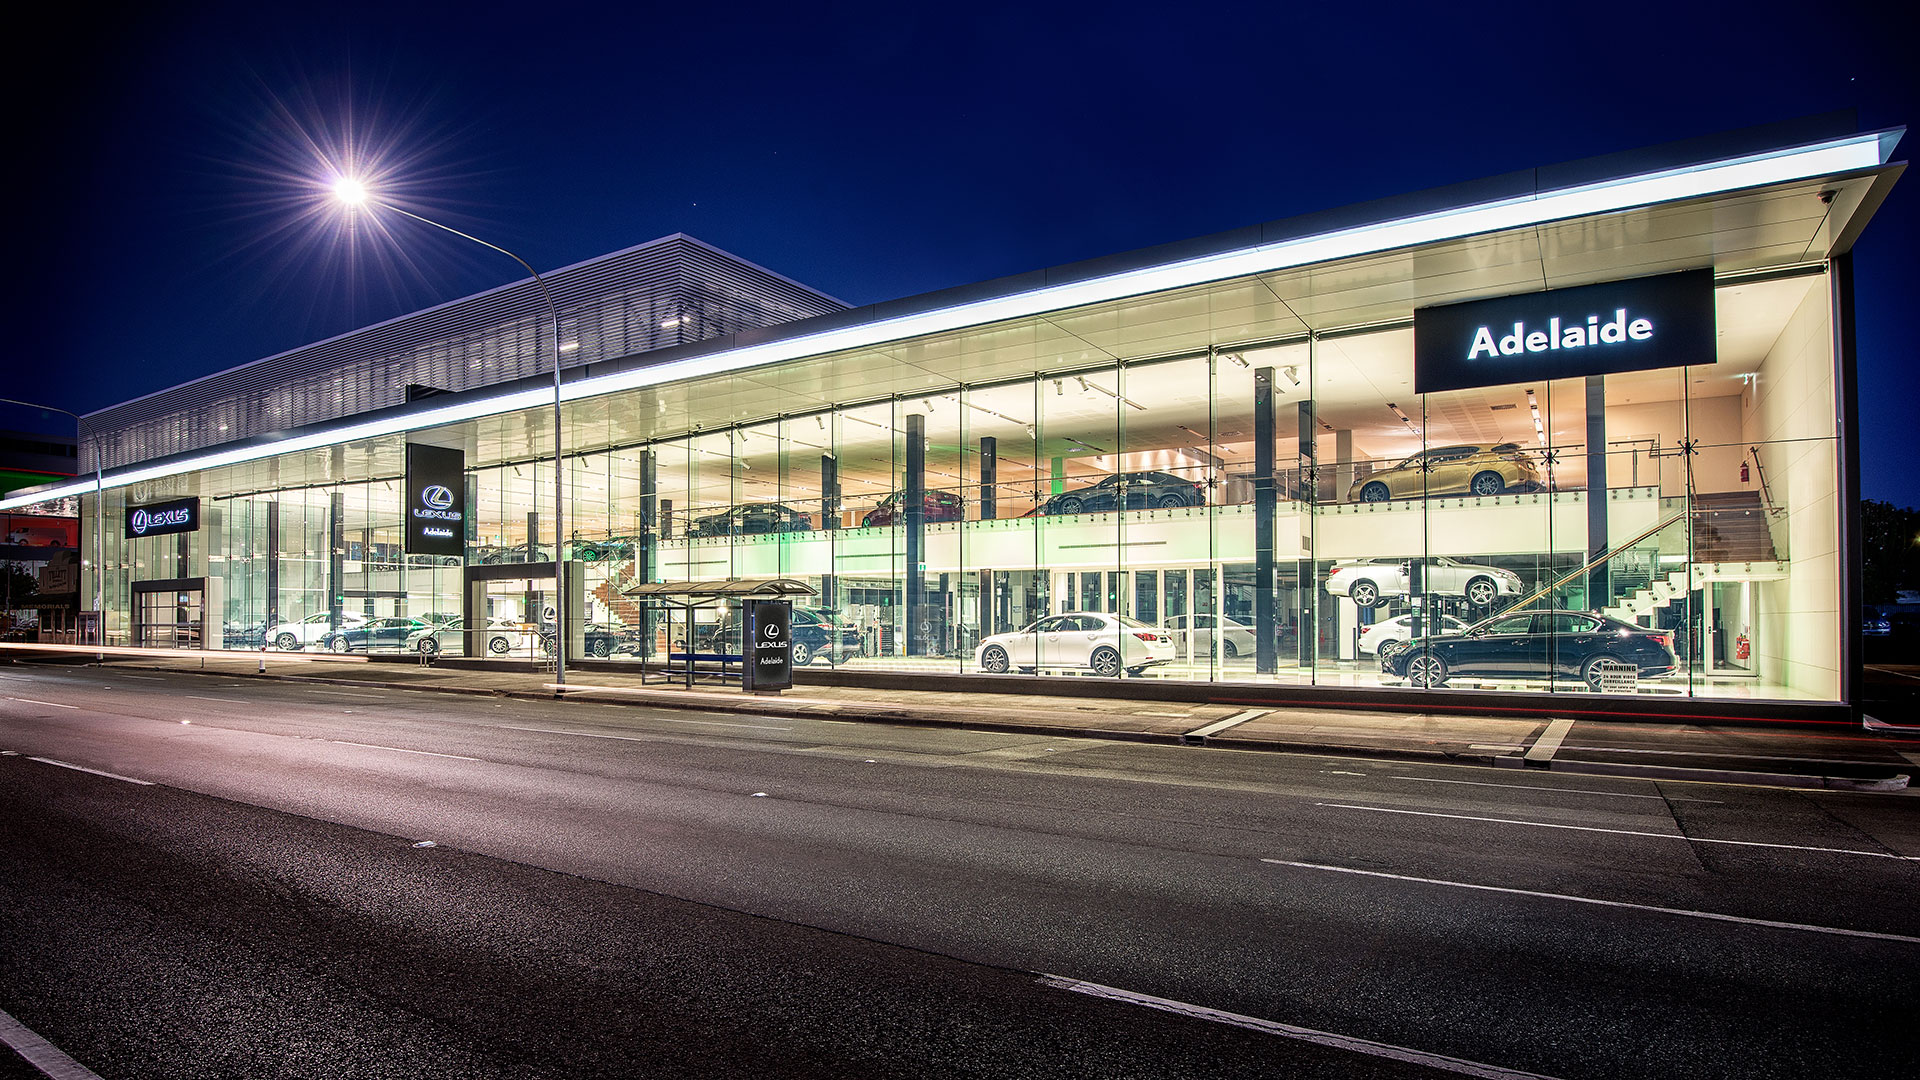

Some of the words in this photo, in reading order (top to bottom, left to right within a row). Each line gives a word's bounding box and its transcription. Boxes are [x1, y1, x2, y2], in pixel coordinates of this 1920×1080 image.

[1467, 308, 1654, 360] Adelaide
[146, 508, 190, 528] LEXUS
[413, 508, 462, 521] LEXUS
[423, 527, 454, 538] Adelaide
[755, 641, 788, 649] LEXUS
[760, 656, 784, 666] Adelaide
